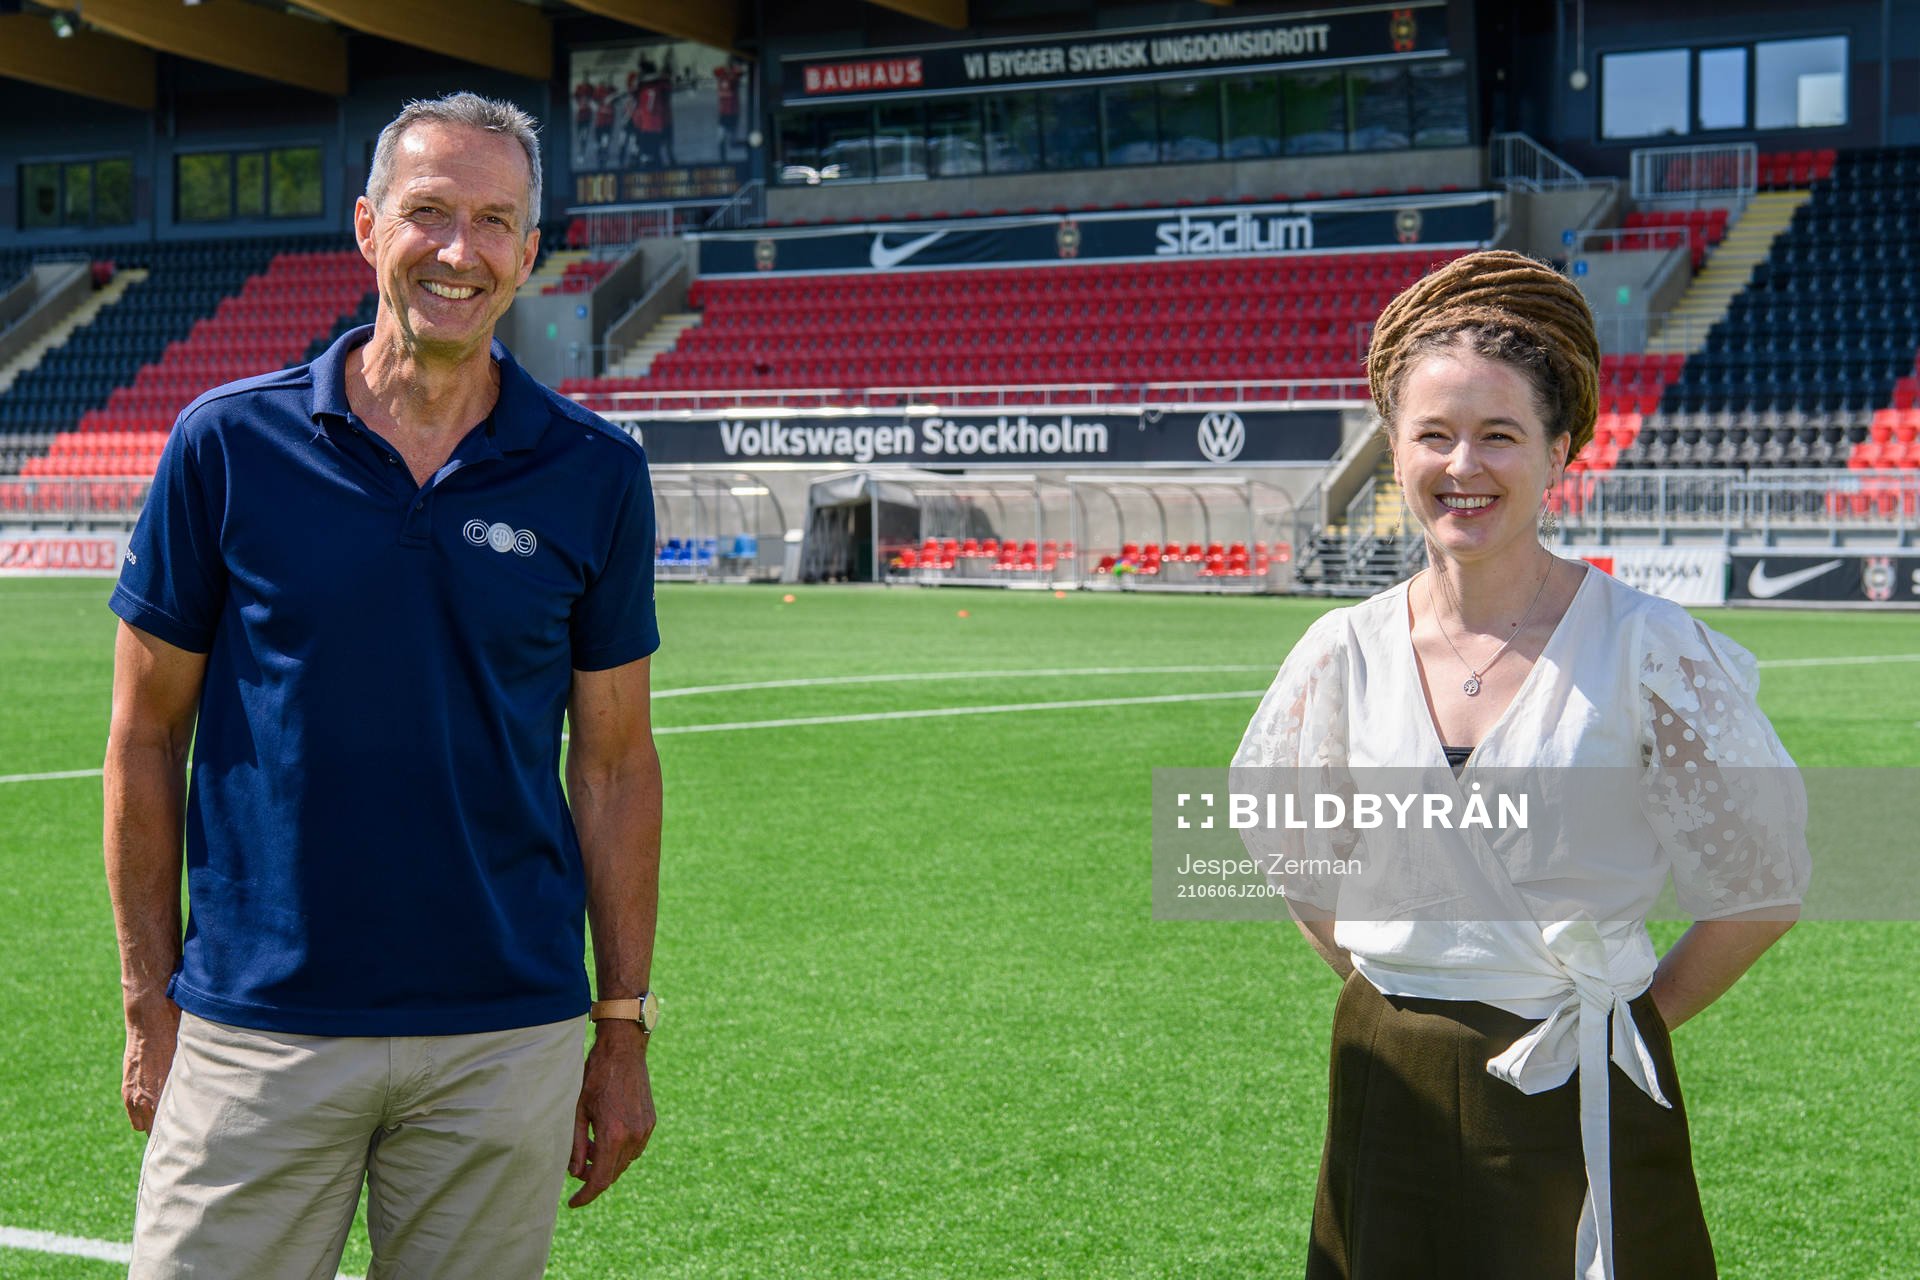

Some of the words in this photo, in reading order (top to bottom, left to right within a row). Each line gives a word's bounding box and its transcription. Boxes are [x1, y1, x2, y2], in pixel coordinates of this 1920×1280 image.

[805, 58, 923, 90] BAUHAUS
[963, 54, 985, 80] VI
[988, 48, 1066, 78] BYGGER
[1068, 41, 1149, 72] SVENSK
[1151, 24, 1330, 65] UNGDOMSIDROTT
[1155, 212, 1313, 255] stadium
[719, 419, 914, 463] Volkswagen
[921, 417, 1108, 454] Stockholm
